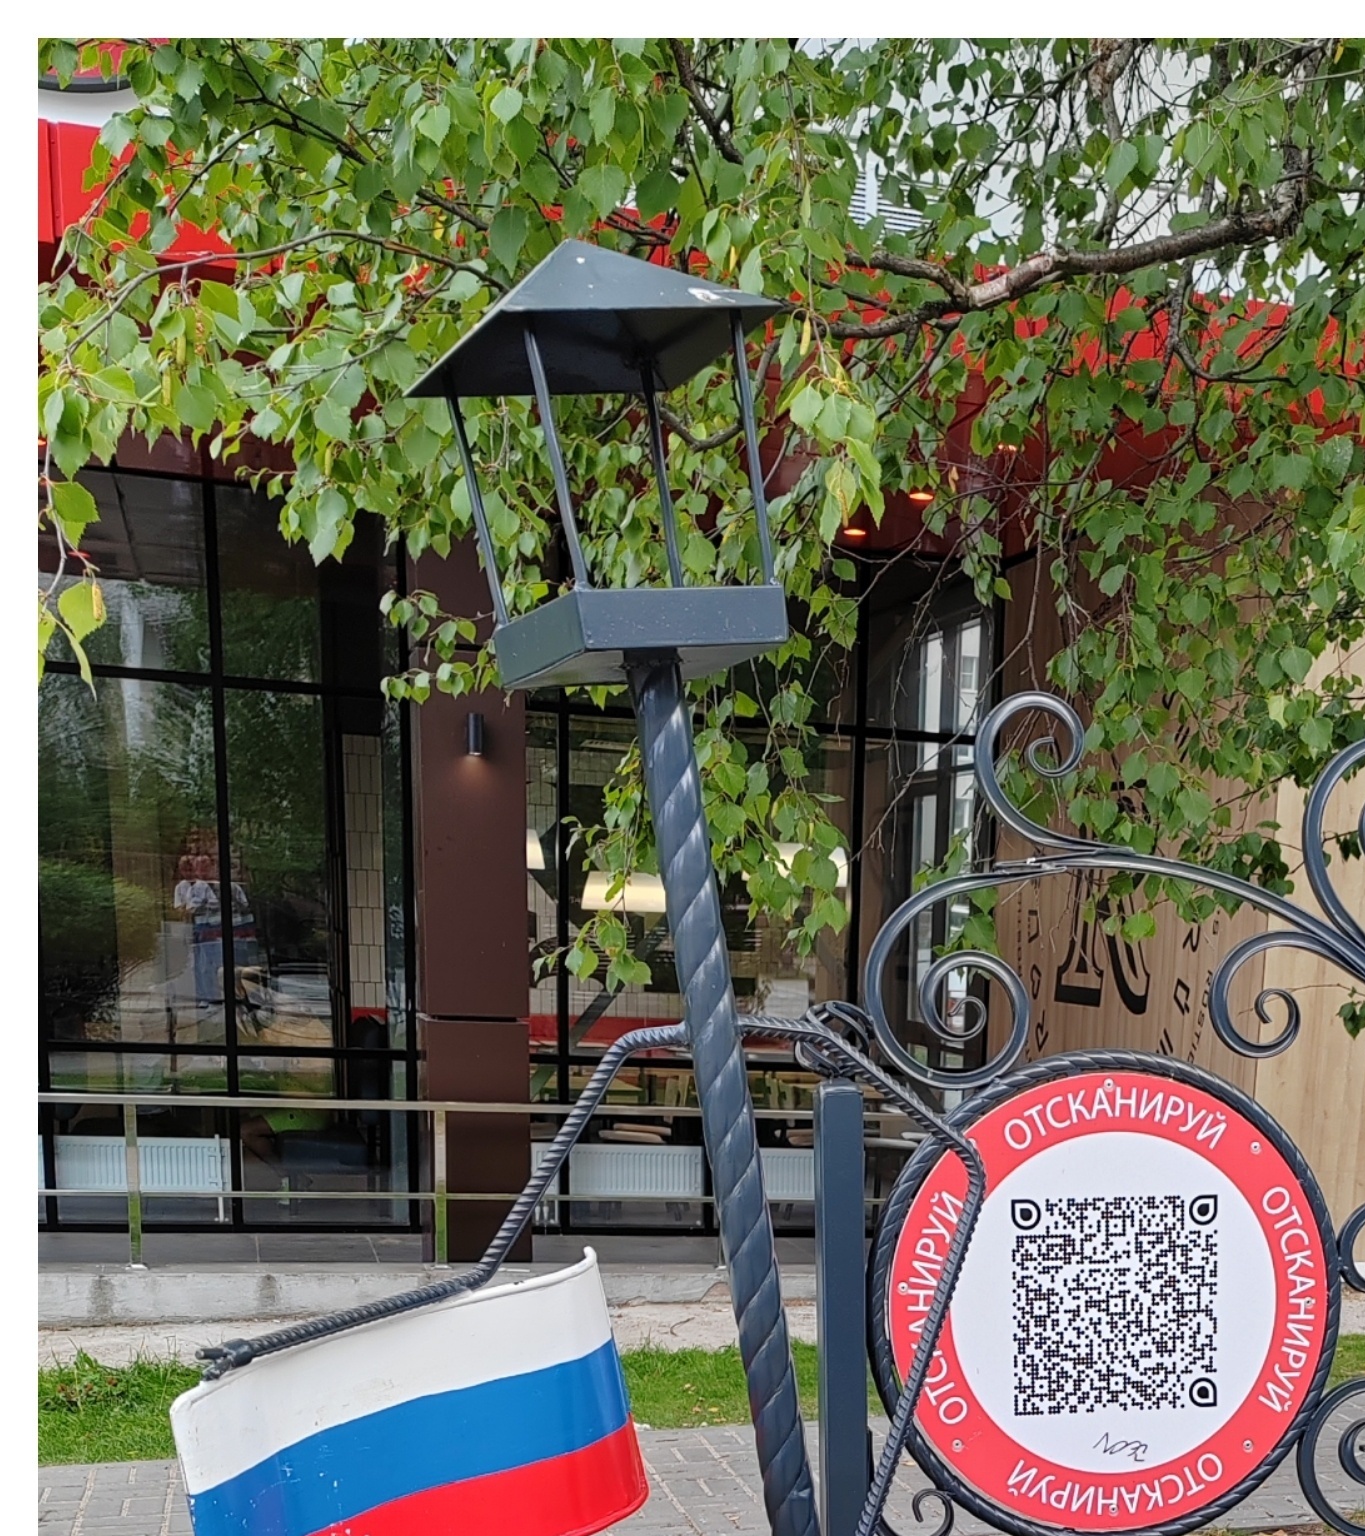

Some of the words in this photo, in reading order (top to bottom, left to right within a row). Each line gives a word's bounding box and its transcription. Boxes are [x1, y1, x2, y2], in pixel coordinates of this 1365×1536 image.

[1003, 1086, 1229, 1151] ОТСКАНИРУЙ
[1258, 1186, 1316, 1414] ОТСКАНИРУЙ
[1006, 1453, 1223, 1514] ОТСКАНИРУЙ
